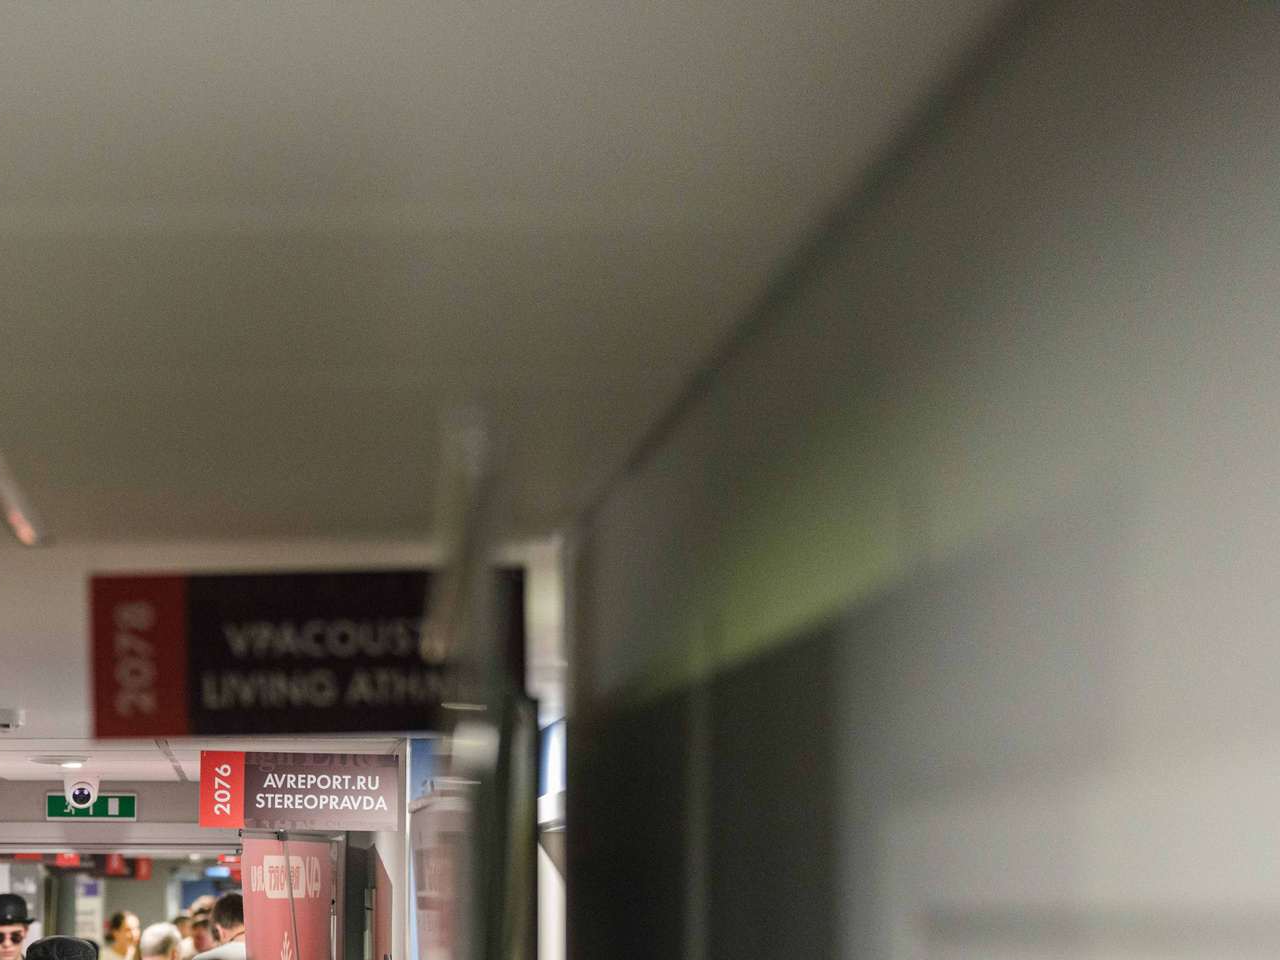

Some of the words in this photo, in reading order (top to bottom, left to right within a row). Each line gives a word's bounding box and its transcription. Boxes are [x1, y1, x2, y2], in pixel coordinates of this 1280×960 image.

[115, 602, 157, 716] 2078
[203, 669, 339, 709] LIVING
[214, 764, 232, 815] 2076
[255, 793, 388, 811] STEREOPRAVDA
[263, 773, 380, 791] AVREPORT.RU
